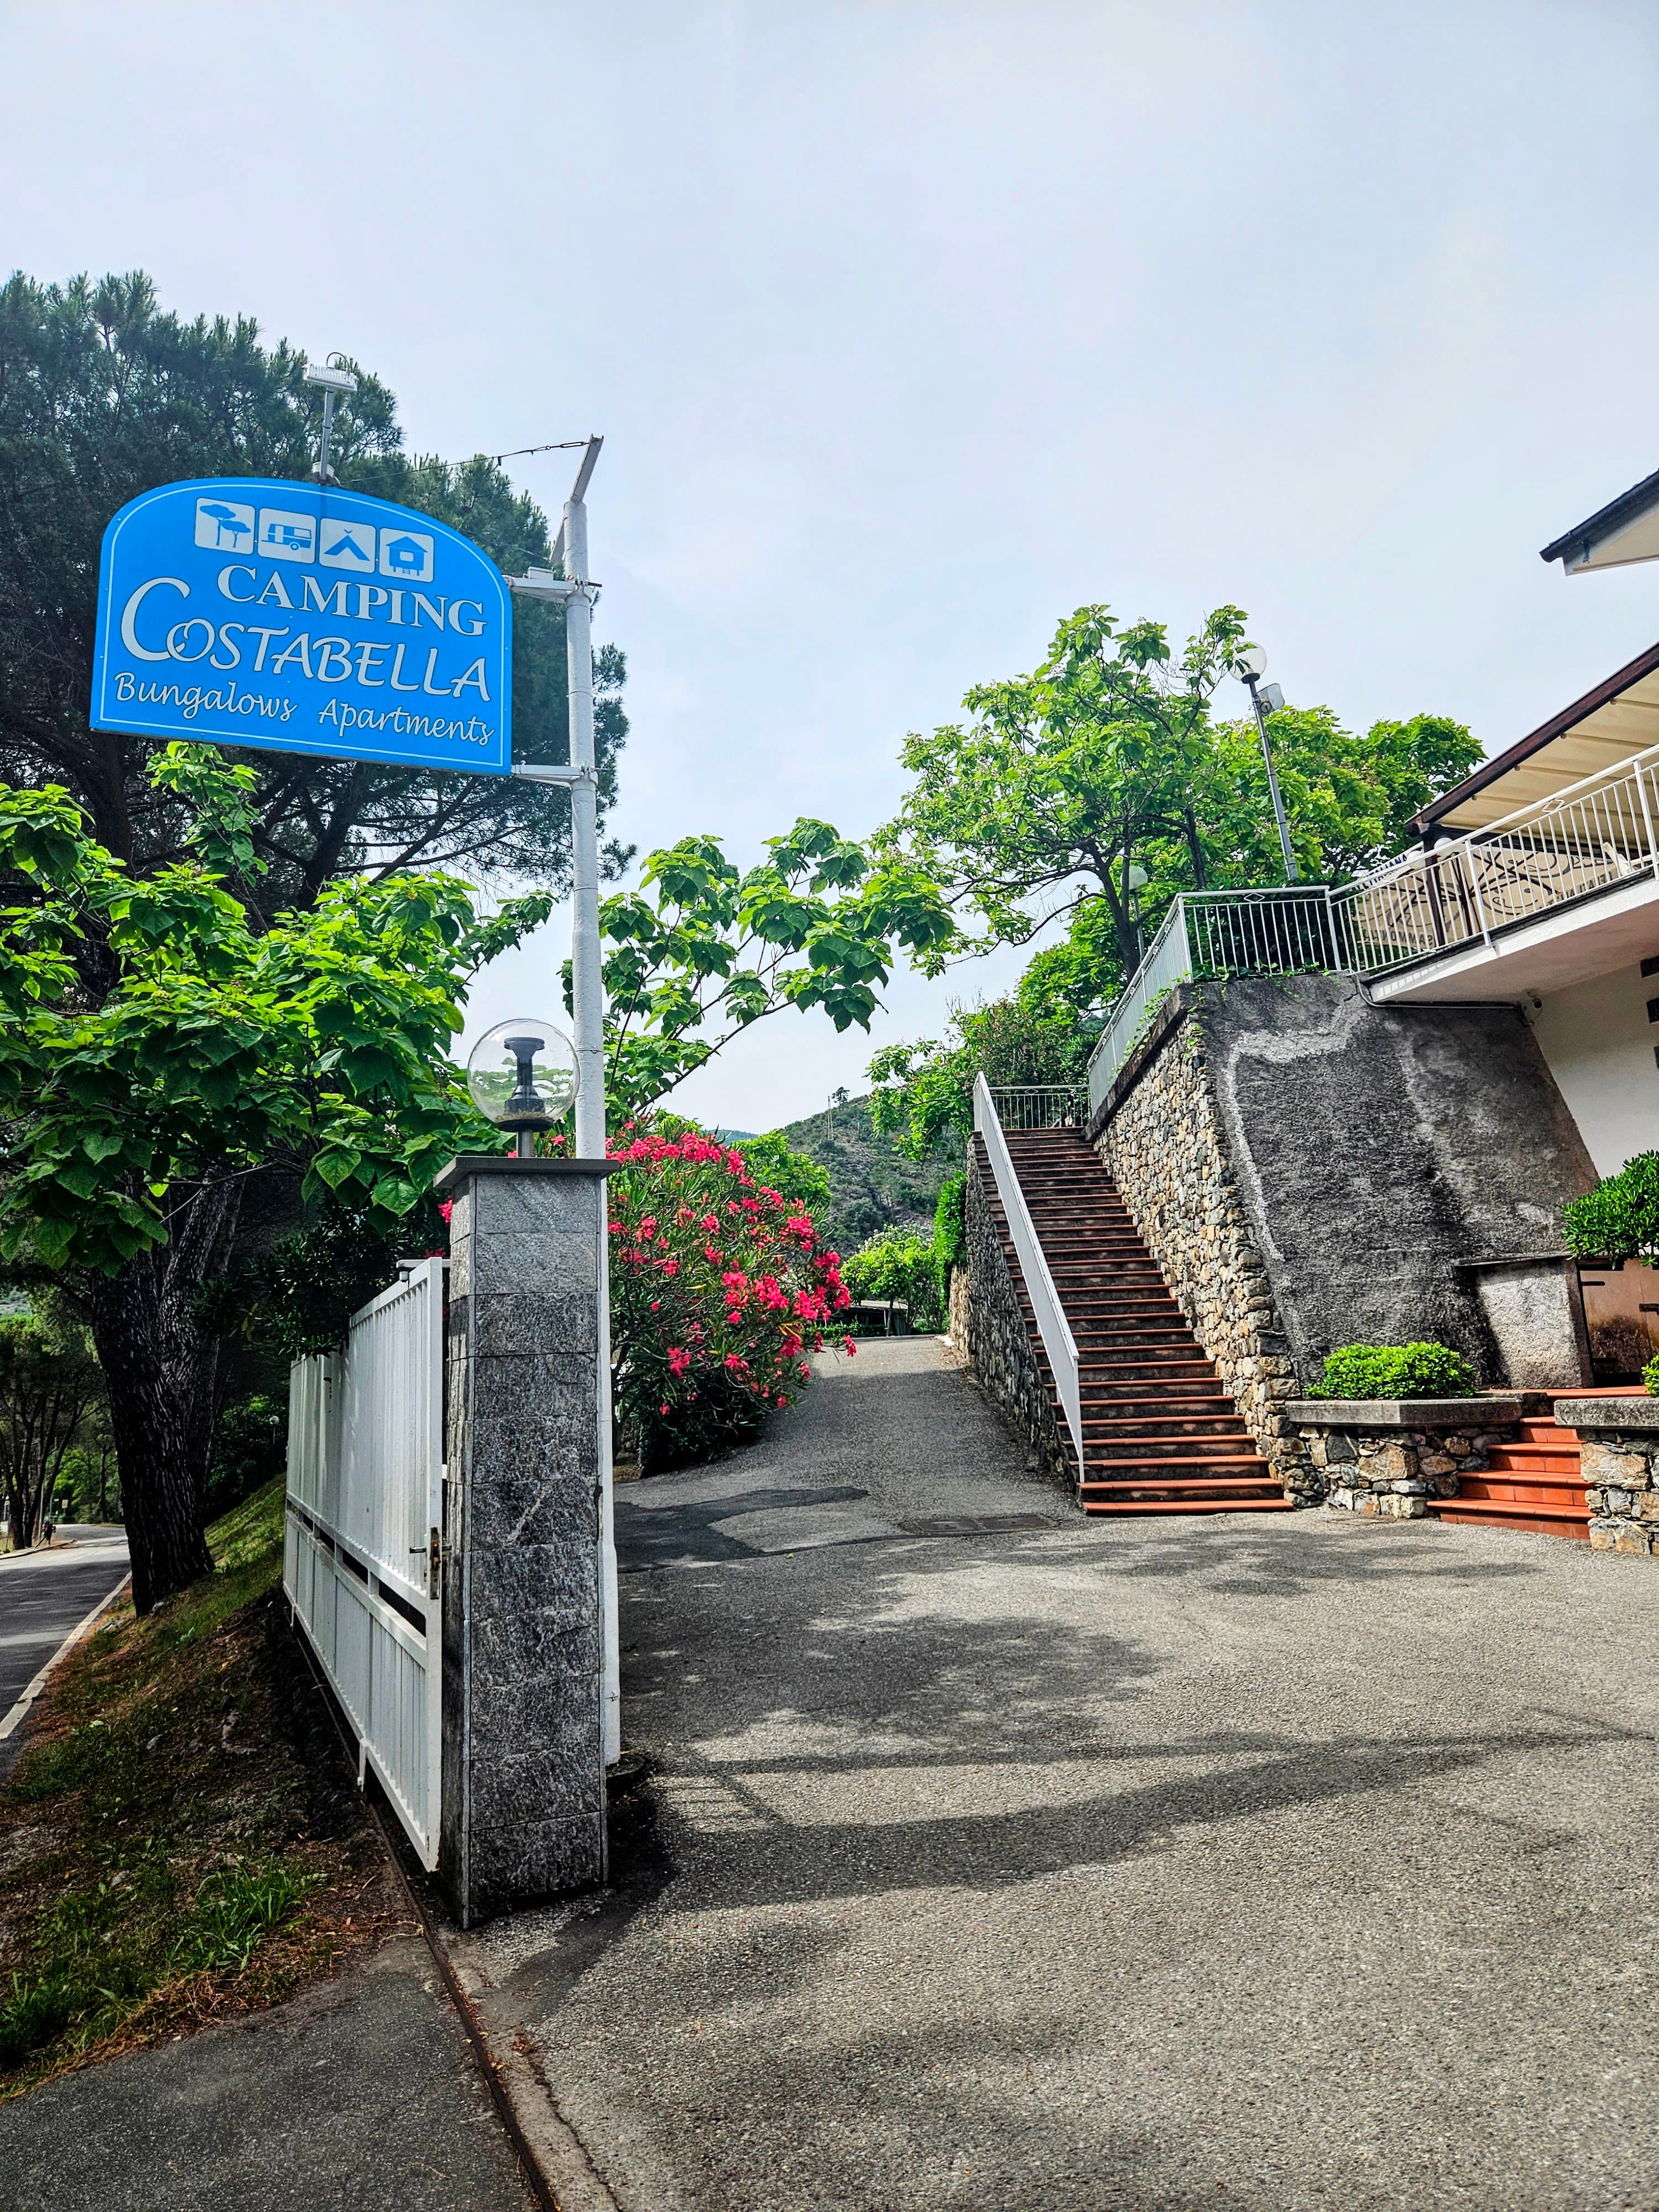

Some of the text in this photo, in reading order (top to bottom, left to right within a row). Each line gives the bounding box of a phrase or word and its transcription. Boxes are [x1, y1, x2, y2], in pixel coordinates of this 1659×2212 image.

[217, 565, 487, 636] CAMPING
[121, 577, 491, 702] COSTABELLA
[114, 671, 494, 745] Bungalows Apartments
